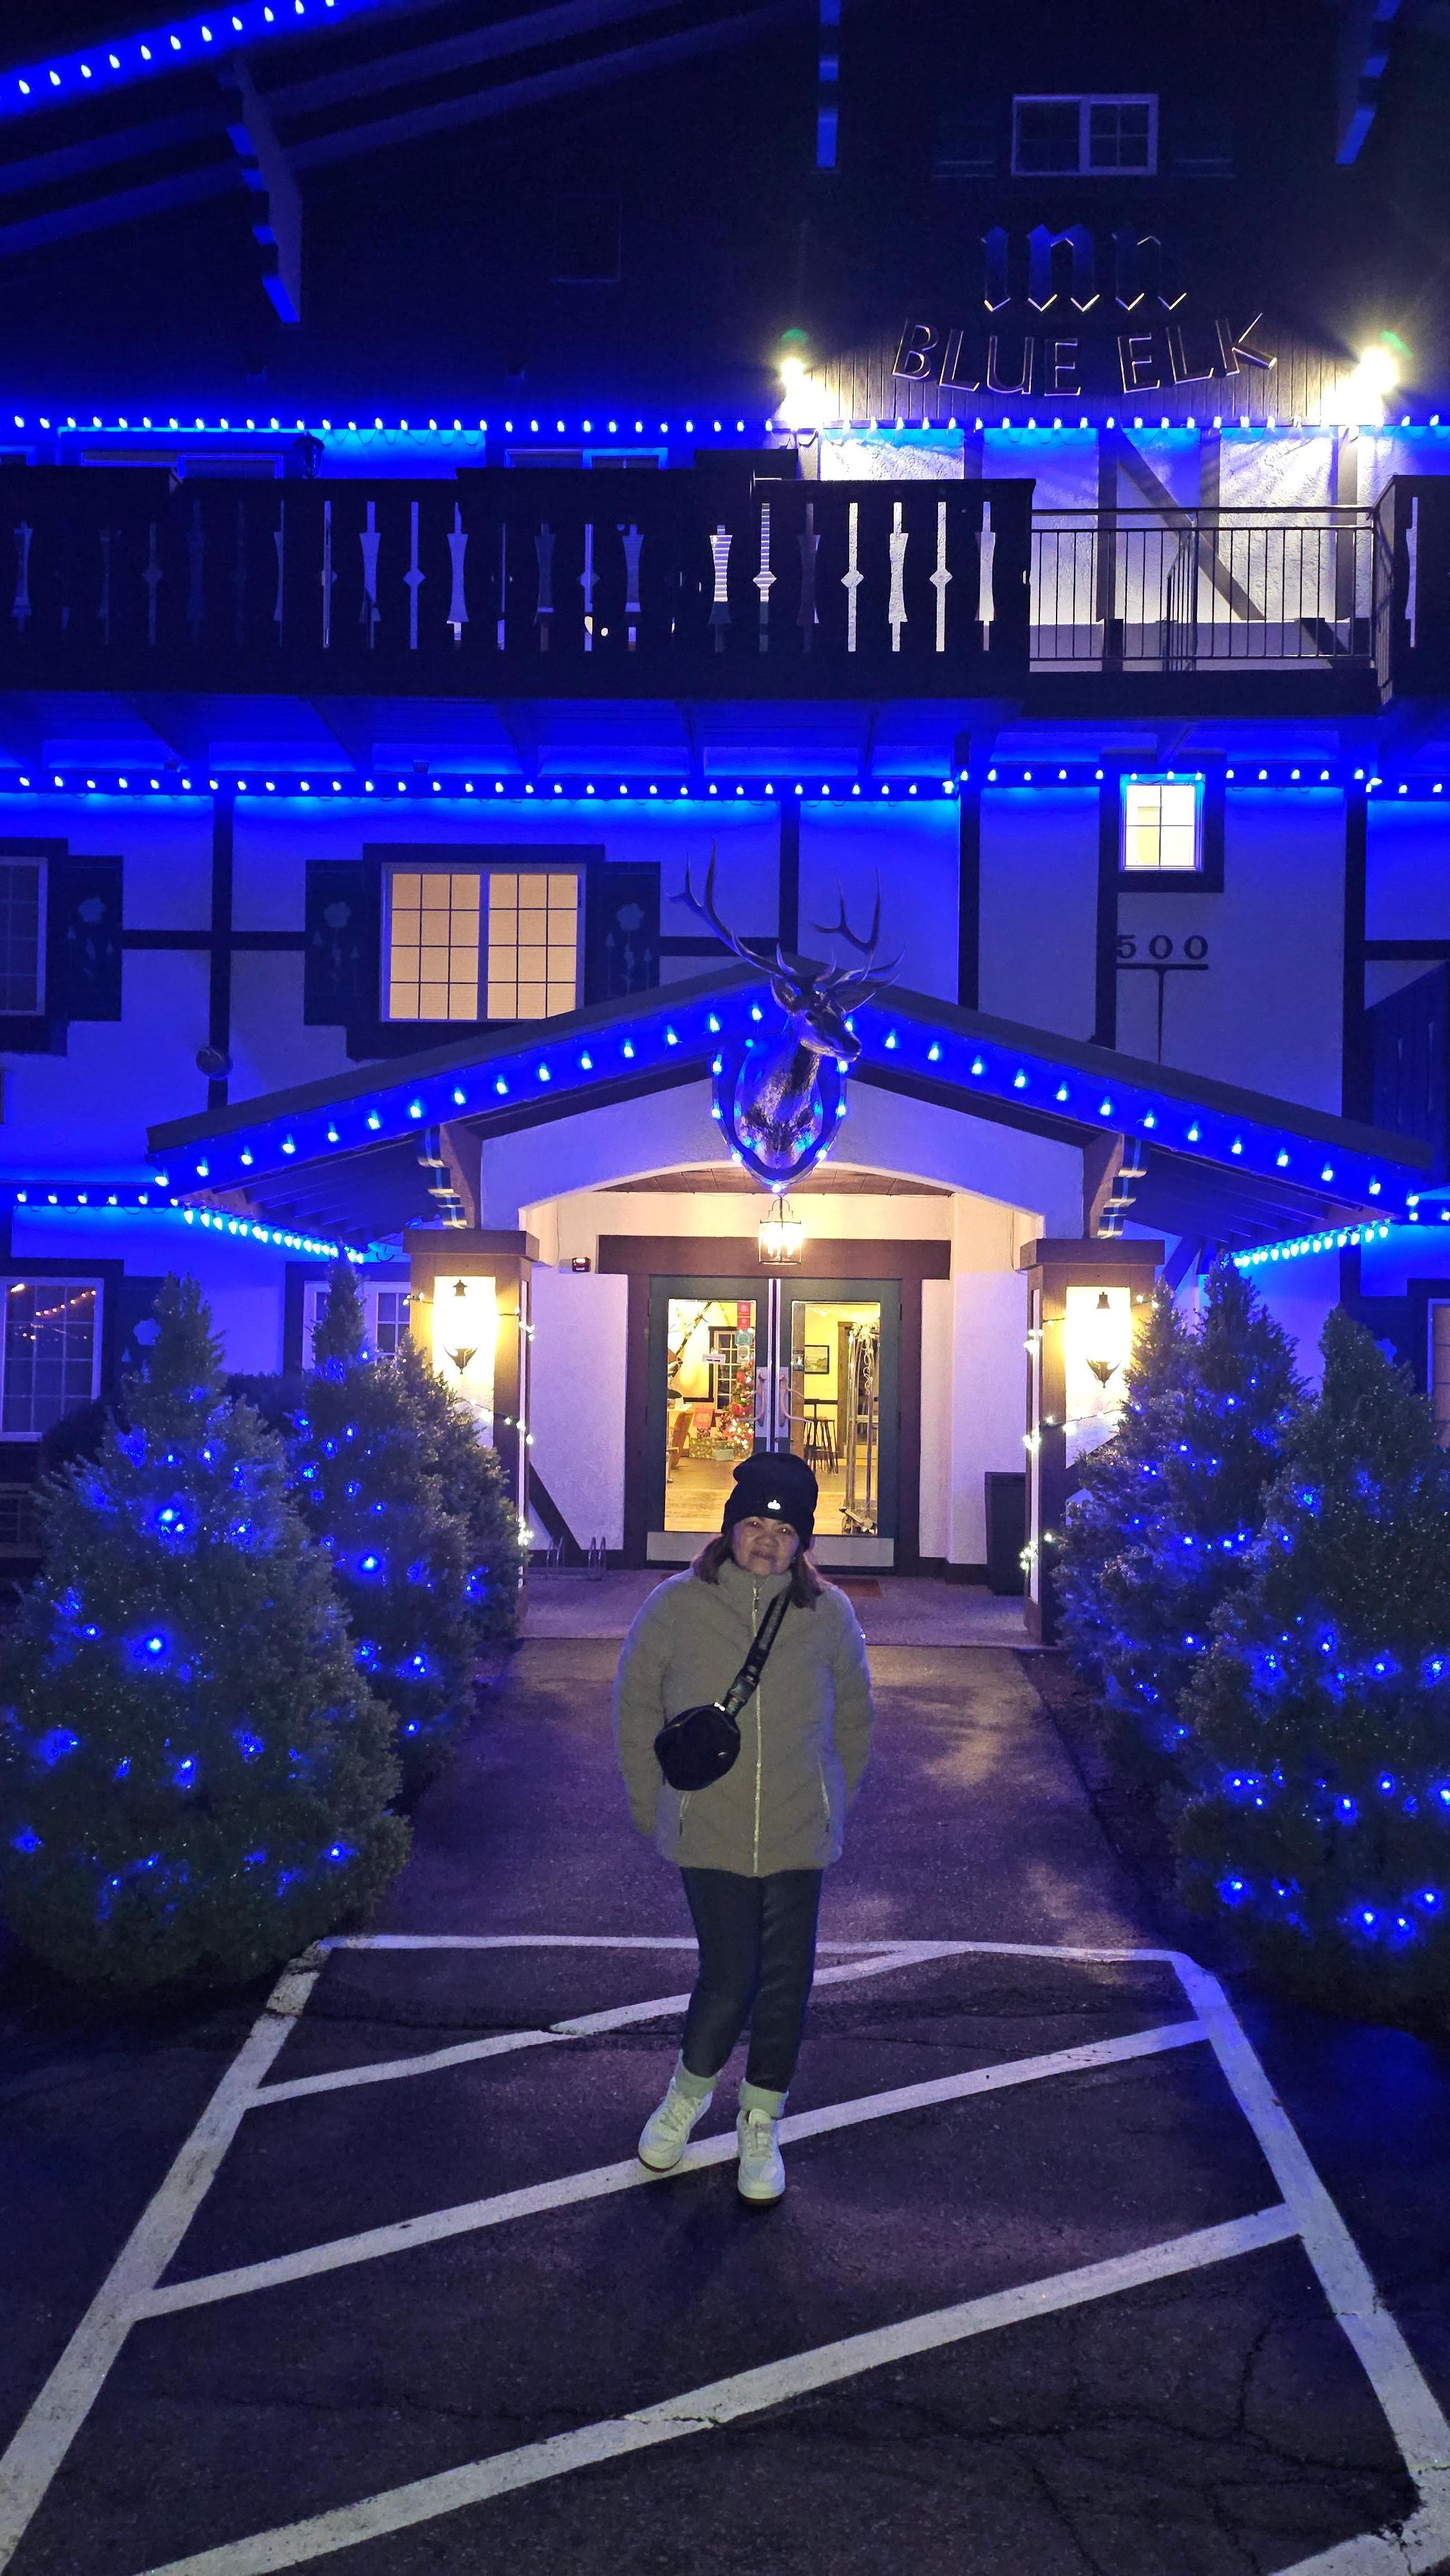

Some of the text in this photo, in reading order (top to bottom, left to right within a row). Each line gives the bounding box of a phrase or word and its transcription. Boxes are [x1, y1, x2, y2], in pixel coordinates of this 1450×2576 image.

[892, 312, 1277, 396] BLUE ELK
[1116, 934, 1208, 960] 500
